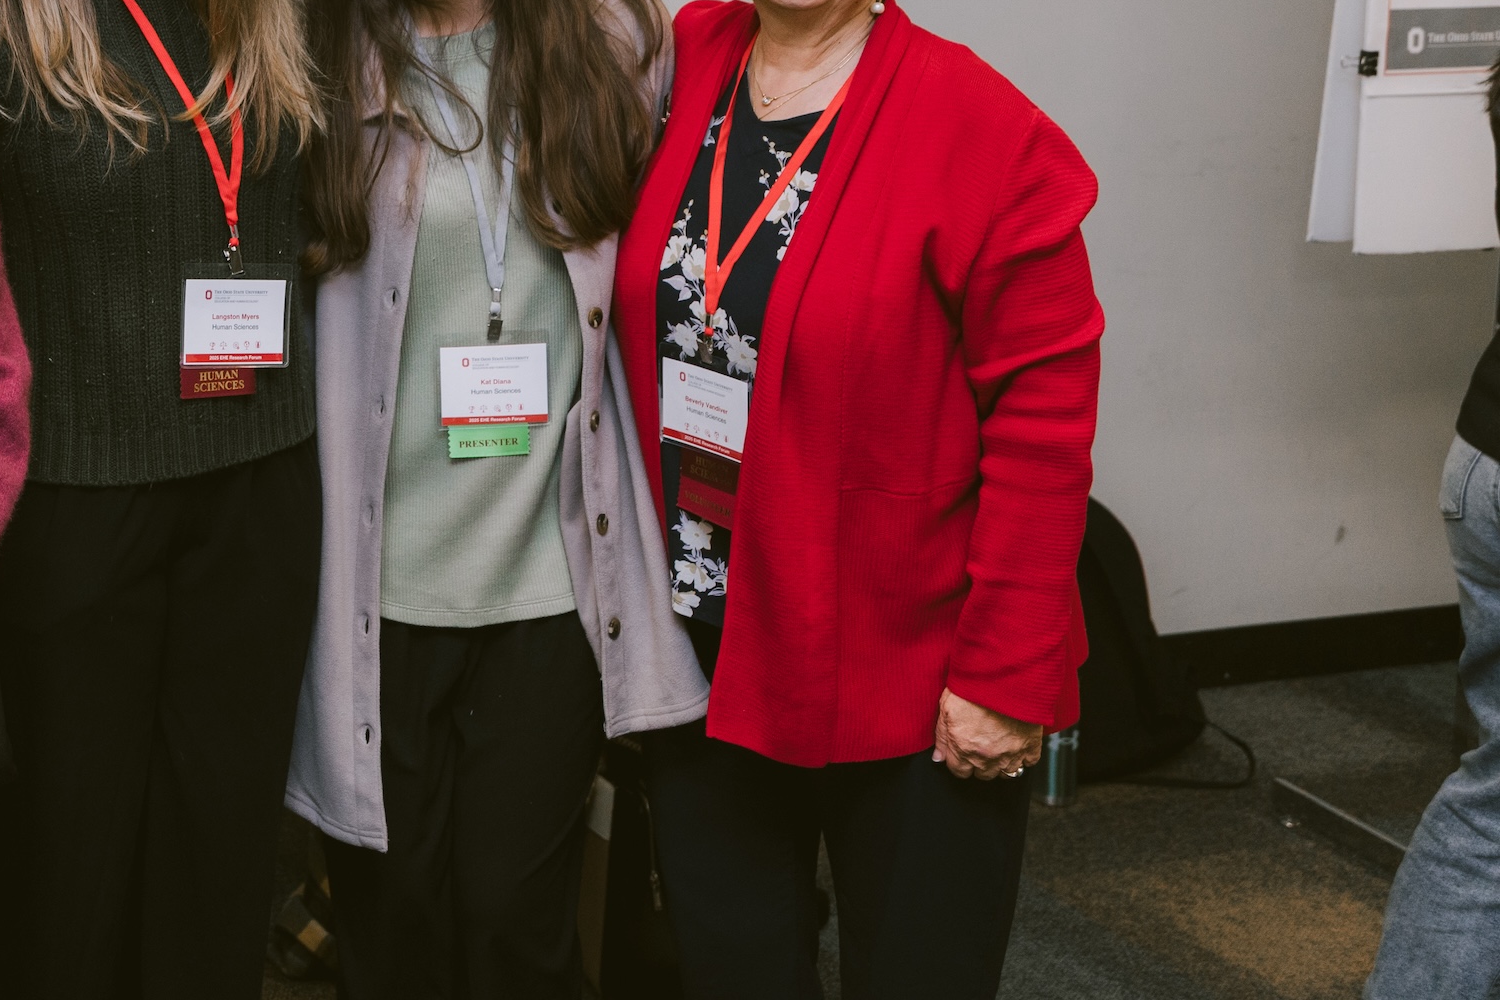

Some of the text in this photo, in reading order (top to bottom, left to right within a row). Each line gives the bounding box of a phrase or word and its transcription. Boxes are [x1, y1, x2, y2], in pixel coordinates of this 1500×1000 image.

[200, 370, 239, 382] HUMAN
[194, 380, 245, 393] SCIENCES
[685, 395, 728, 415] Beverly Vandiver
[686, 406, 727, 425] Human Sciences
[460, 438, 518, 448] PRESENTER
